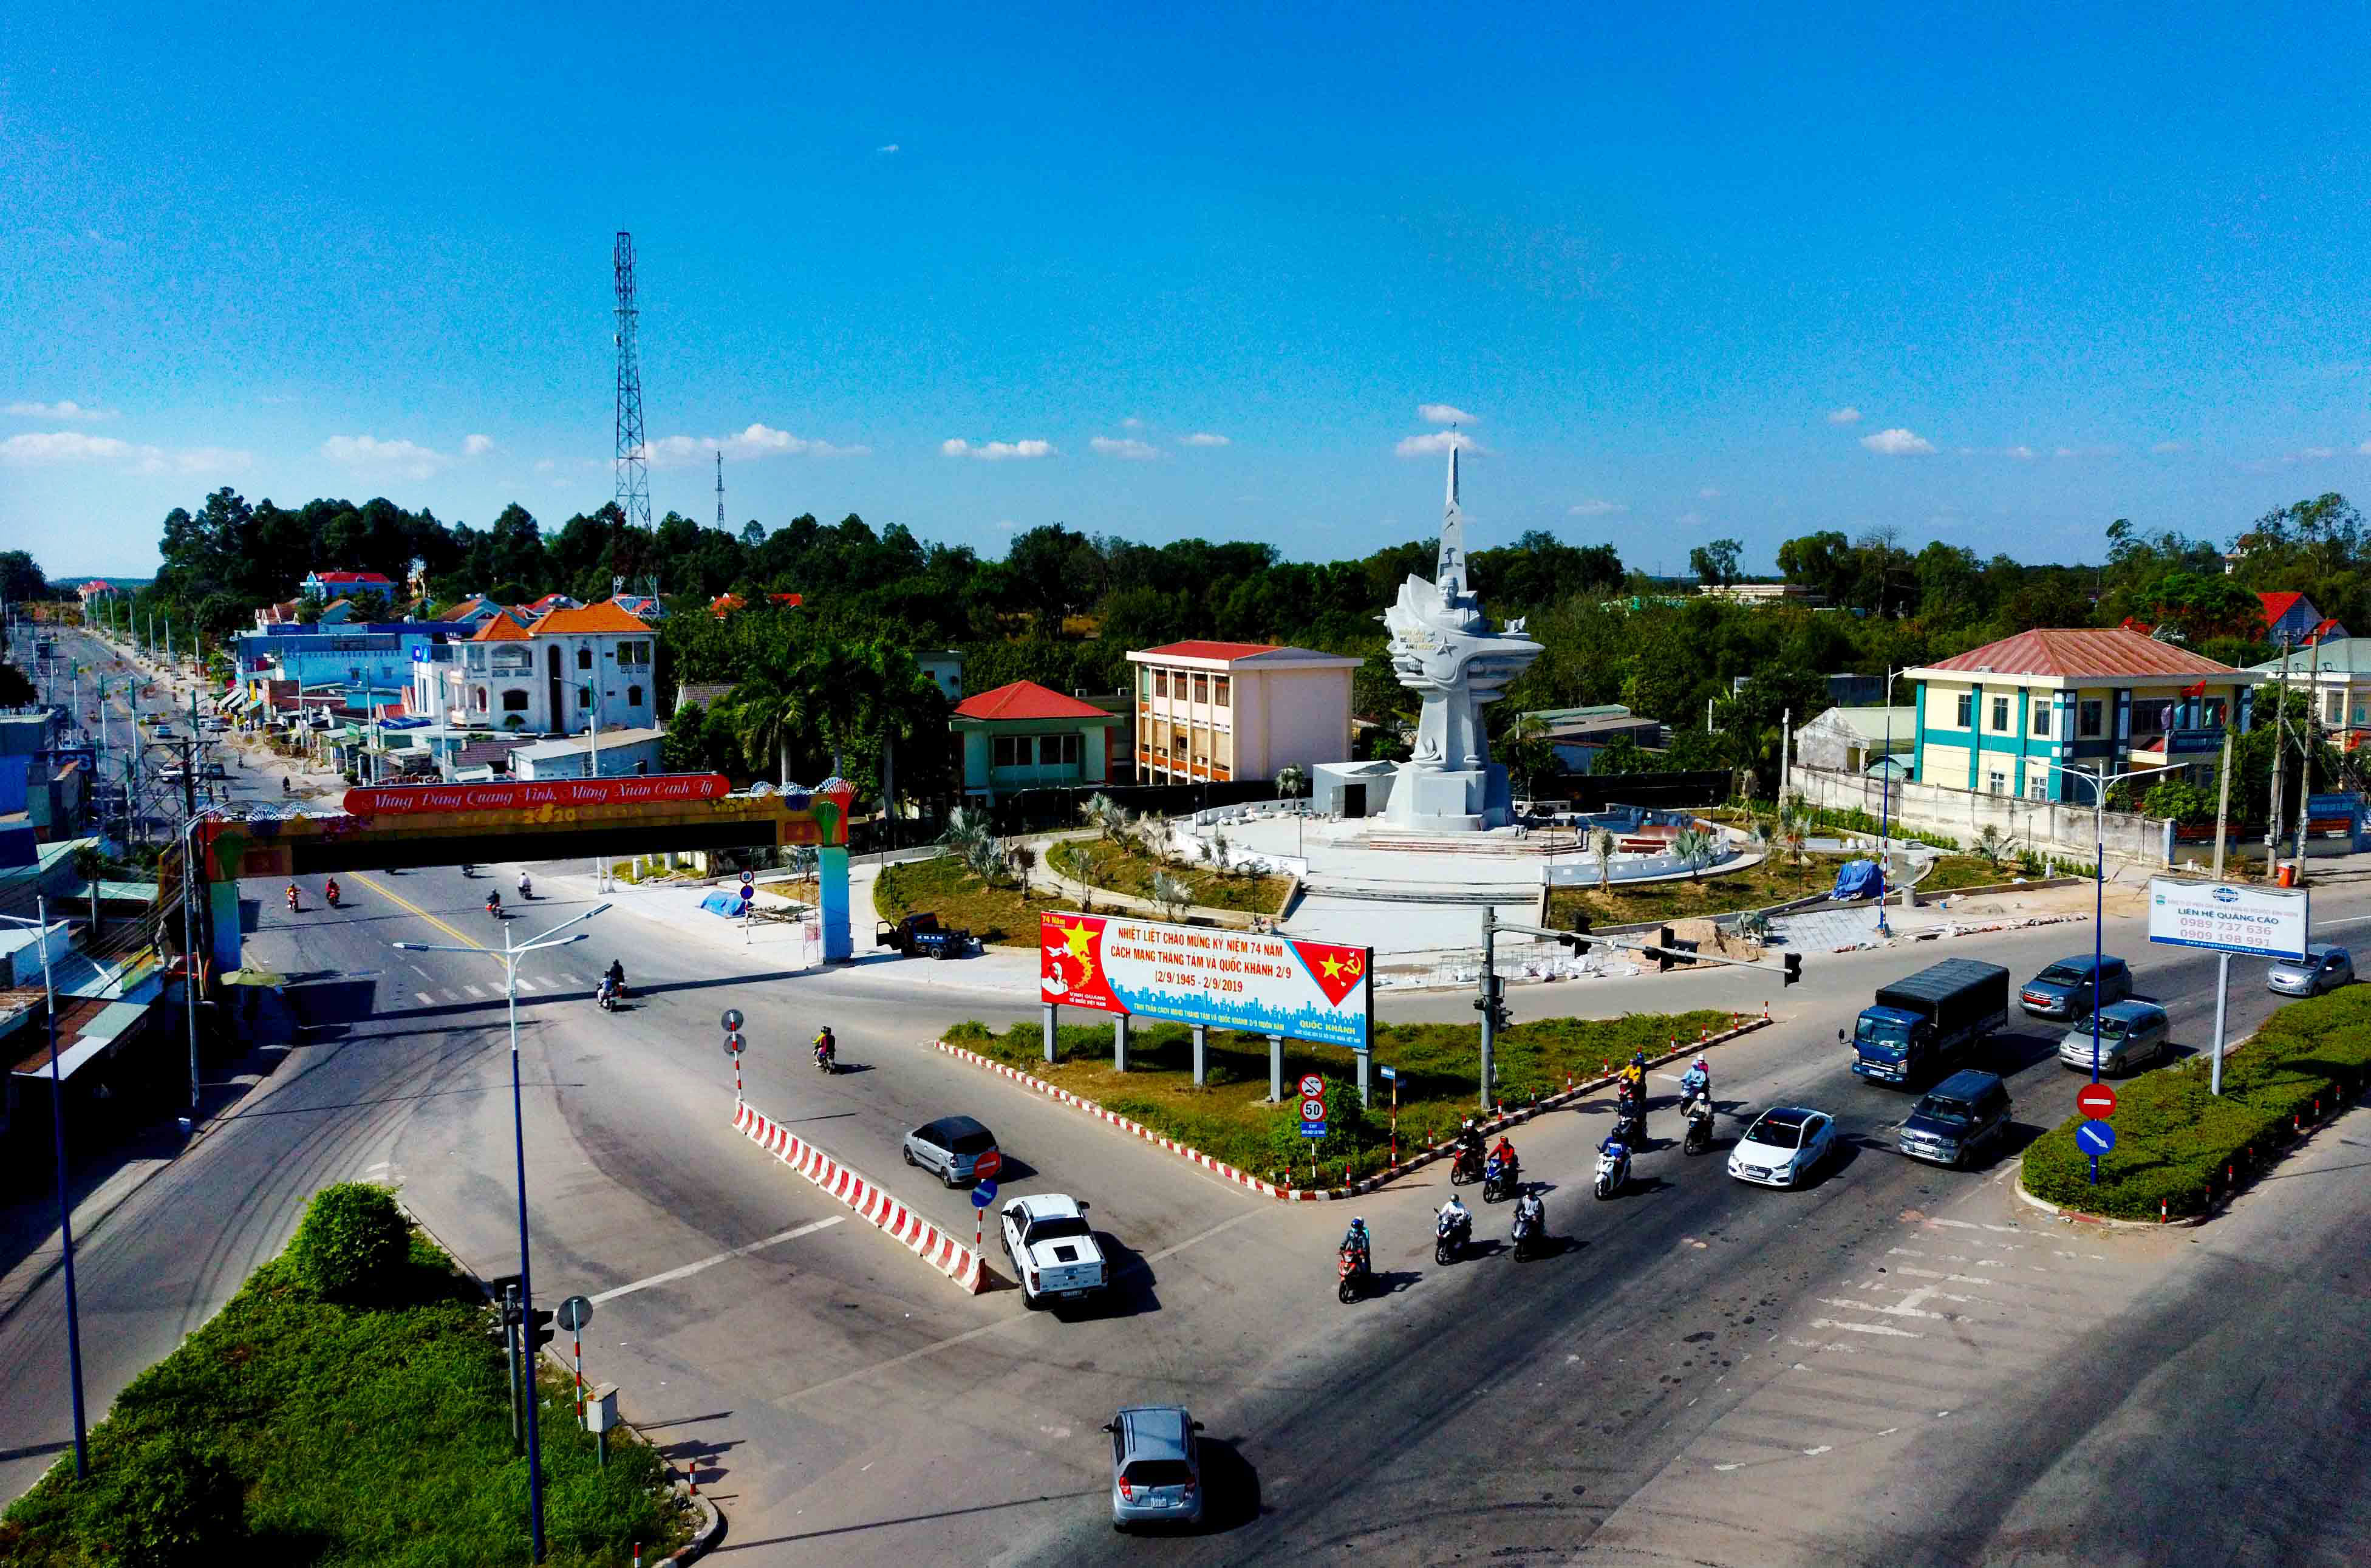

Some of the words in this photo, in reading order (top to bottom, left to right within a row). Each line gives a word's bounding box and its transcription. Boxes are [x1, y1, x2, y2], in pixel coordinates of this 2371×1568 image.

[1042, 915, 1050, 923] 74
[2180, 918, 2212, 929] 0989
[2217, 921, 2240, 932] 737
[2246, 924, 2272, 935] 636
[1118, 925, 1141, 943] NHIỆT
[1144, 927, 1161, 944] LIỆT
[1163, 930, 1184, 946] CHÀO
[1187, 933, 1210, 949] MỪNG
[1227, 937, 1248, 954] NIỆM
[1250, 942, 1261, 954] 74
[1264, 942, 1283, 957] NĂM
[2180, 929, 2212, 940] 0909
[2219, 933, 2241, 944] 198
[2246, 936, 2270, 947] 991
[1110, 943, 1131, 959] CÁCH
[1133, 948, 1156, 963] MẠNG
[1158, 949, 1184, 965] THÁNG
[1186, 952, 1204, 968] TÁM
[1206, 954, 1216, 970] VÀ
[1220, 956, 1242, 973] QUỐC
[1244, 960, 1273, 977] KHÁNH
[1276, 966, 1292, 978] 2/9
[1299, 1020, 1323, 1030] QUỐC
[1325, 1023, 1356, 1035] KHÁNH
[1305, 1104, 1320, 1115] 50
